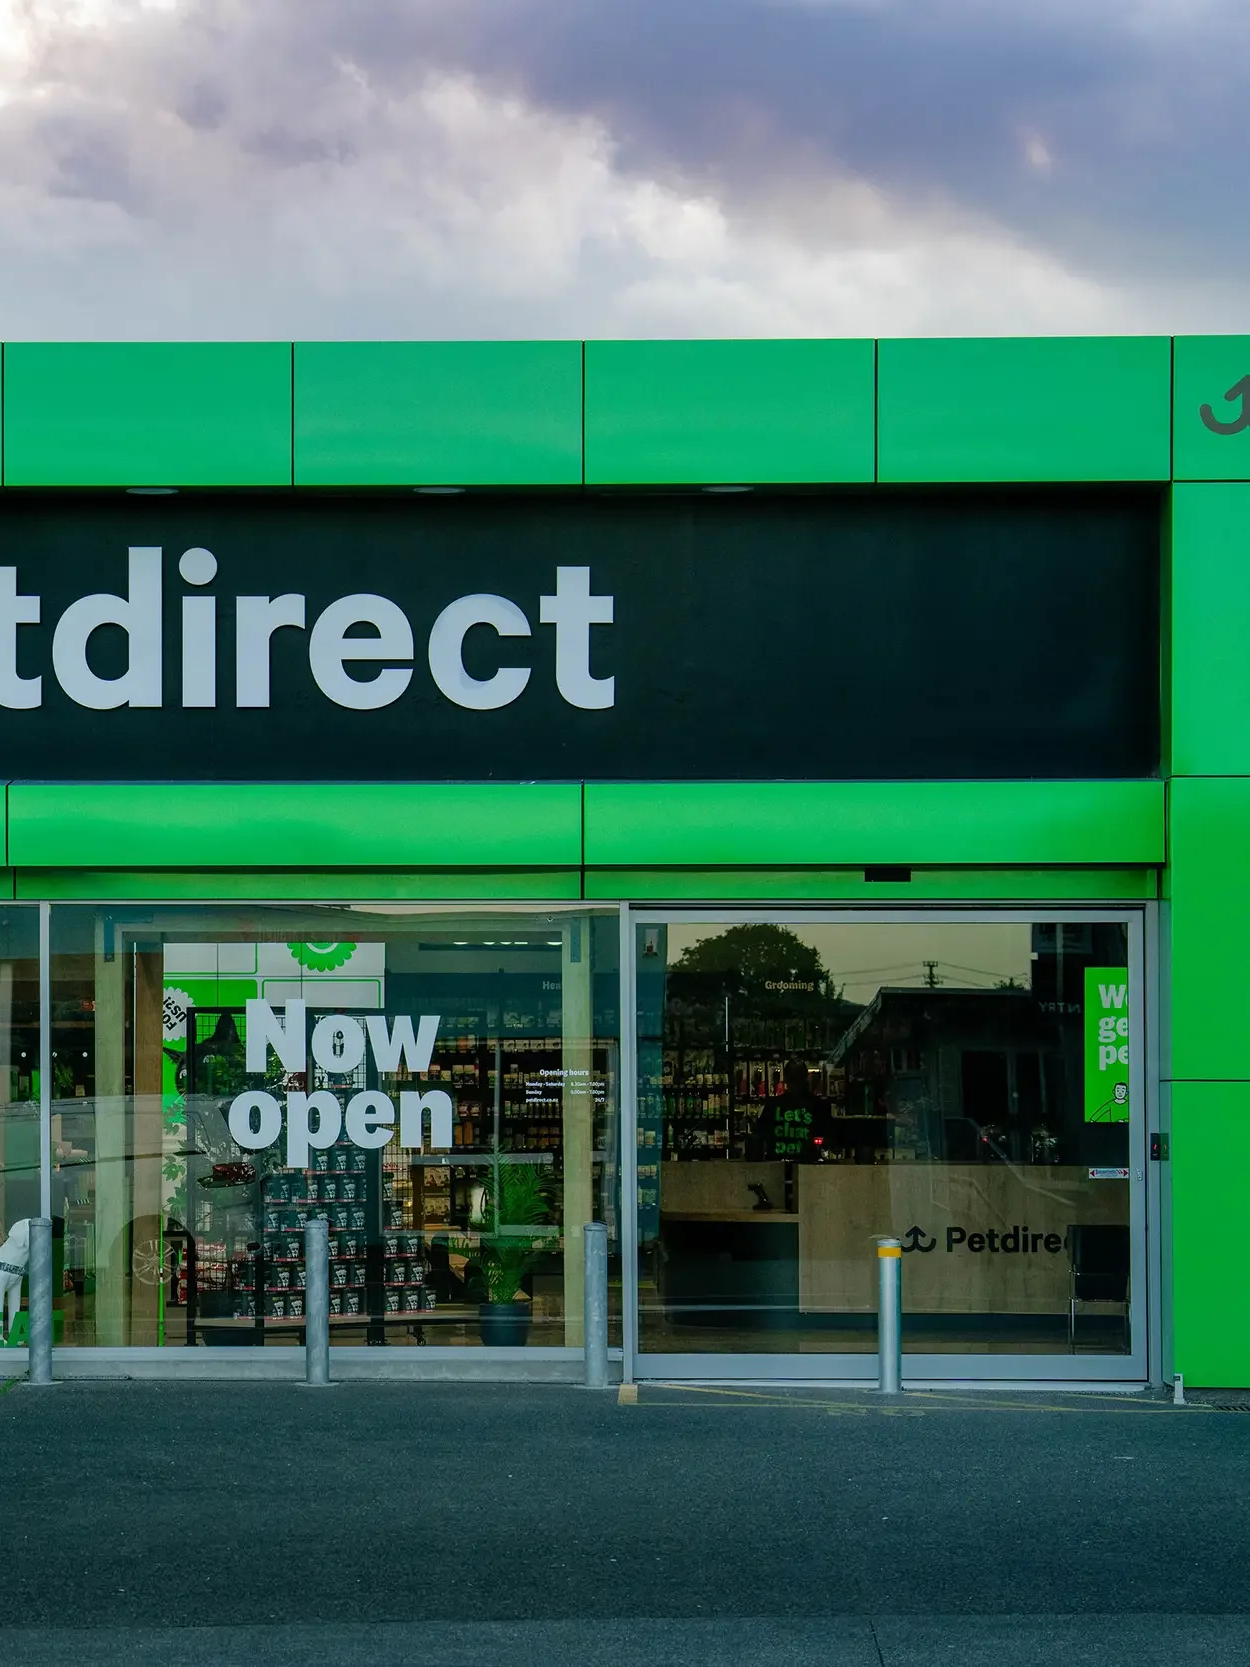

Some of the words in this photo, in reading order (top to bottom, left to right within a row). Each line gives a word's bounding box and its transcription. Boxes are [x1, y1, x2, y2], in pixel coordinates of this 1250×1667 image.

[764, 980, 814, 992] Grooming
[1098, 984, 1129, 1009] W
[245, 999, 441, 1073] Now
[539, 1068, 568, 1077] Opening
[569, 1068, 589, 1076] hours
[228, 1089, 453, 1168] open
